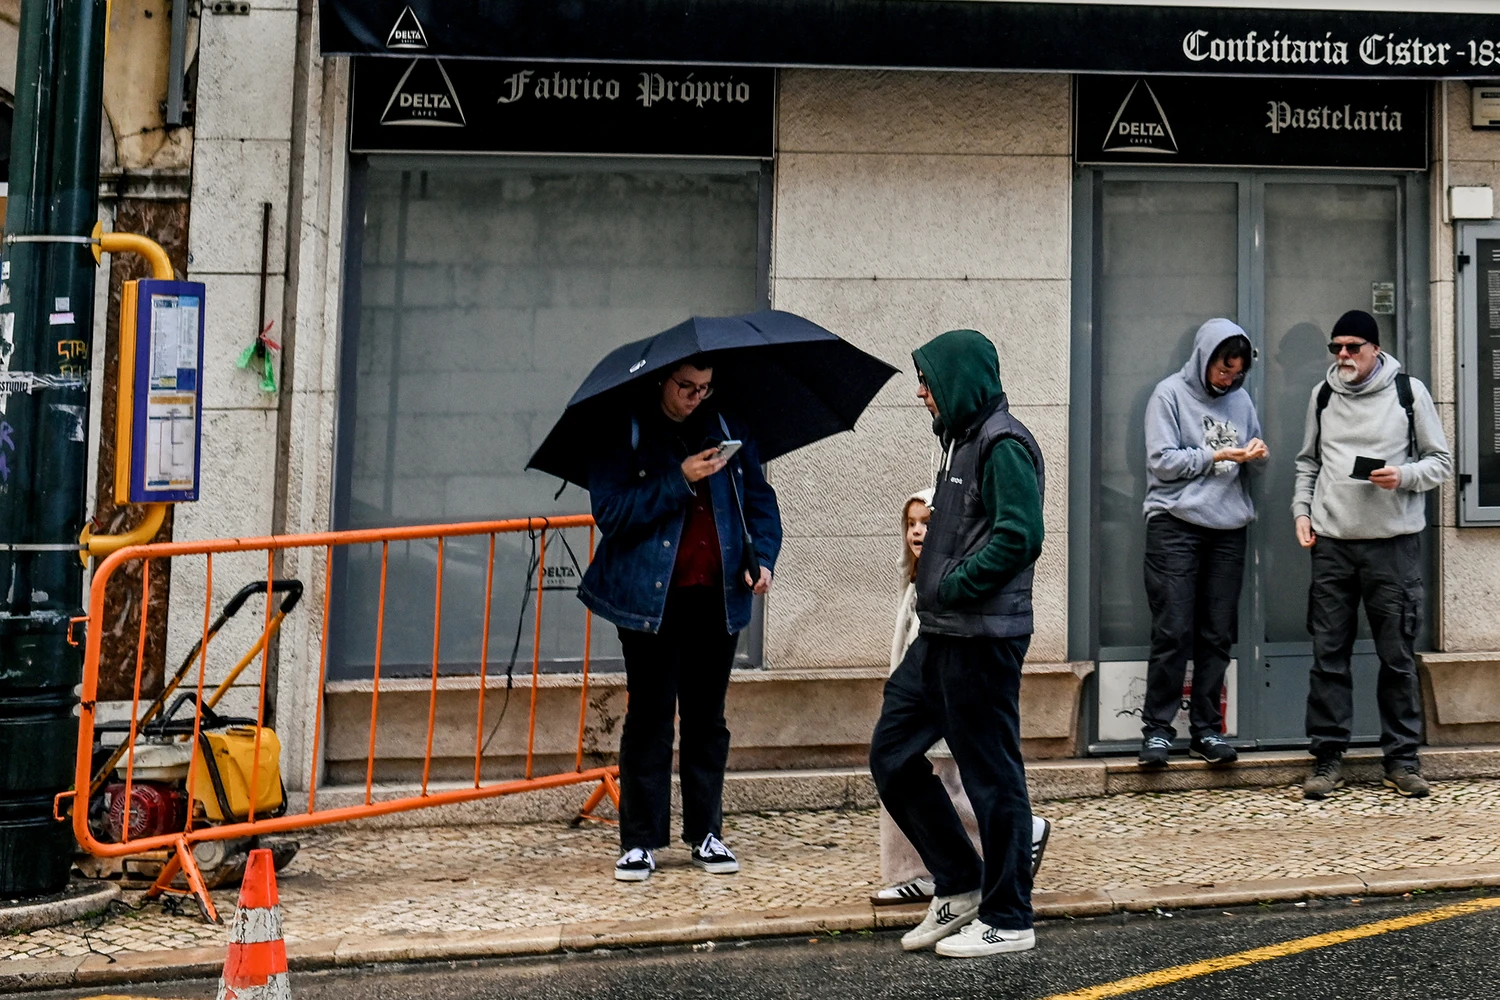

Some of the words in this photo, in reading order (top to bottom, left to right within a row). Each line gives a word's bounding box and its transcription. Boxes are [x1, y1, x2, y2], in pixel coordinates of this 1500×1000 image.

[395, 30, 421, 40] DELTA
[1183, 29, 1349, 65] Confeitaria
[1359, 33, 1451, 66] Cister
[400, 92, 452, 108] DELTA
[497, 69, 620, 104] Fabrico
[636, 72, 750, 108] Próprio
[1118, 122, 1165, 137] DELTA
[1265, 100, 1402, 134] Pastelaria
